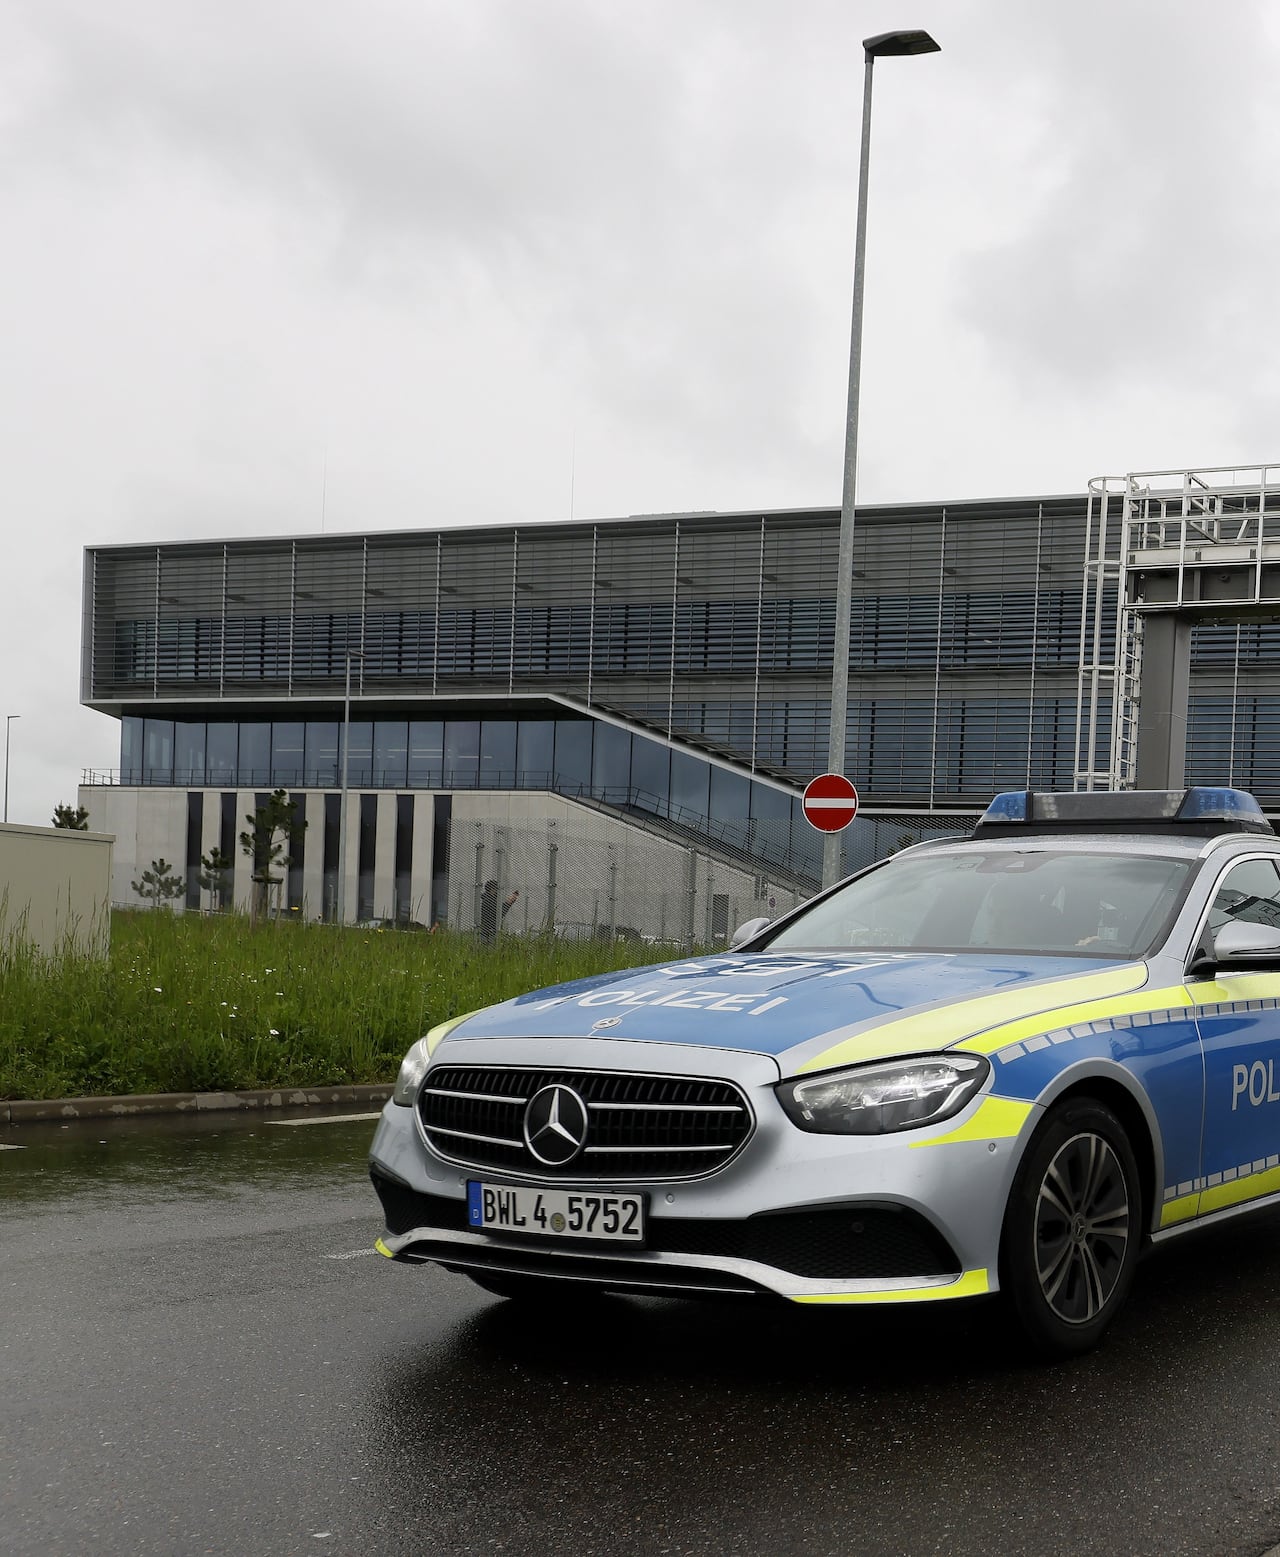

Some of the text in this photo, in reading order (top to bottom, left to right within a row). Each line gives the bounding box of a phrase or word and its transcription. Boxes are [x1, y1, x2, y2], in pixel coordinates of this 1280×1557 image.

[533, 990, 789, 1016] POLIZEI
[473, 1208, 479, 1219] D
[483, 1188, 639, 1235] BWL 4 5752
